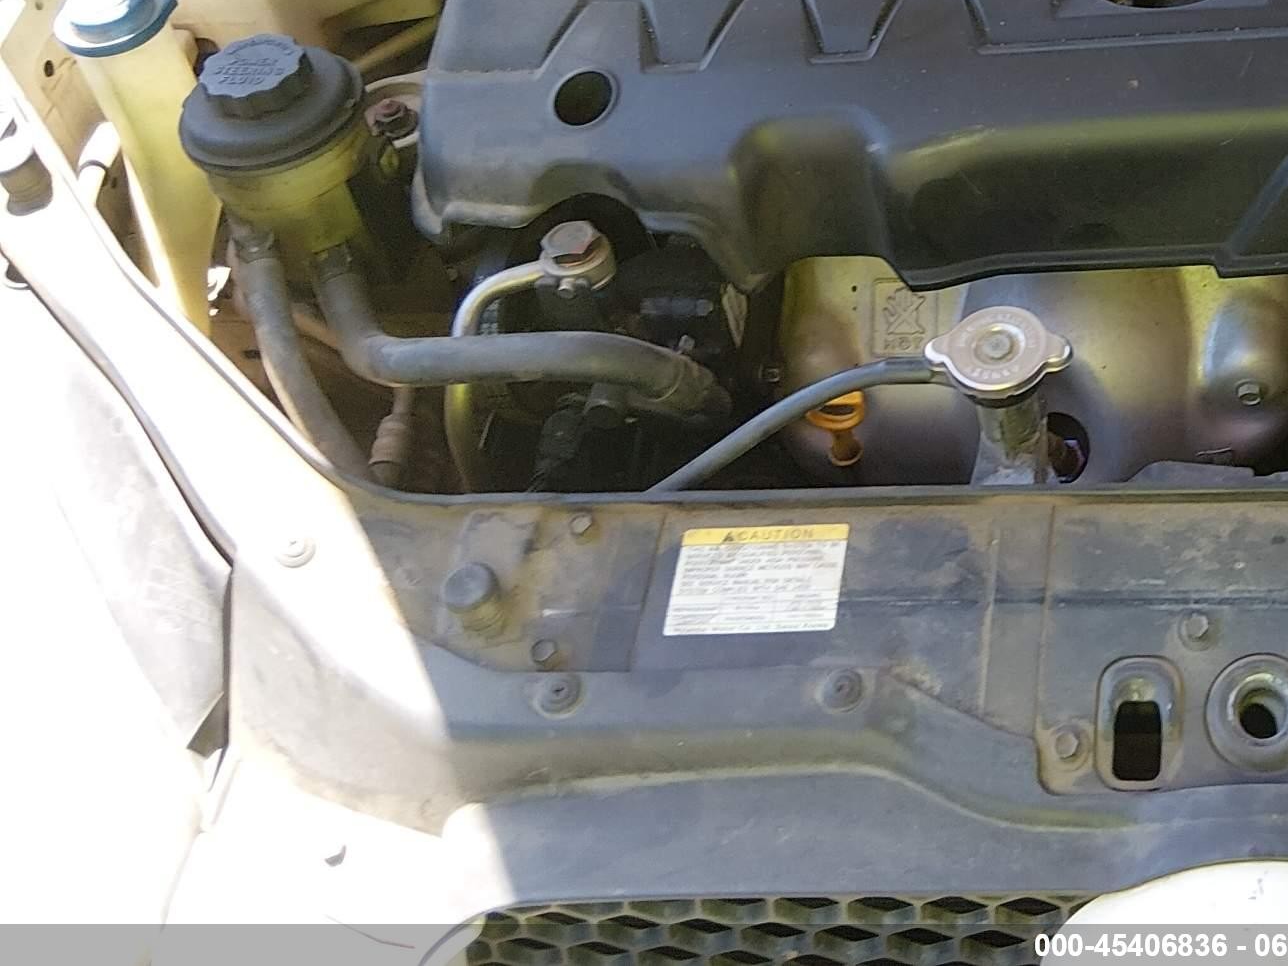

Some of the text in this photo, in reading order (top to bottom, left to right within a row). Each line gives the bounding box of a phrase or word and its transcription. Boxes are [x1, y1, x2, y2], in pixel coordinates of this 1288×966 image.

[215, 66, 285, 75] STEERING
[218, 75, 264, 85] FLUID
[739, 529, 814, 541] CAUTION
